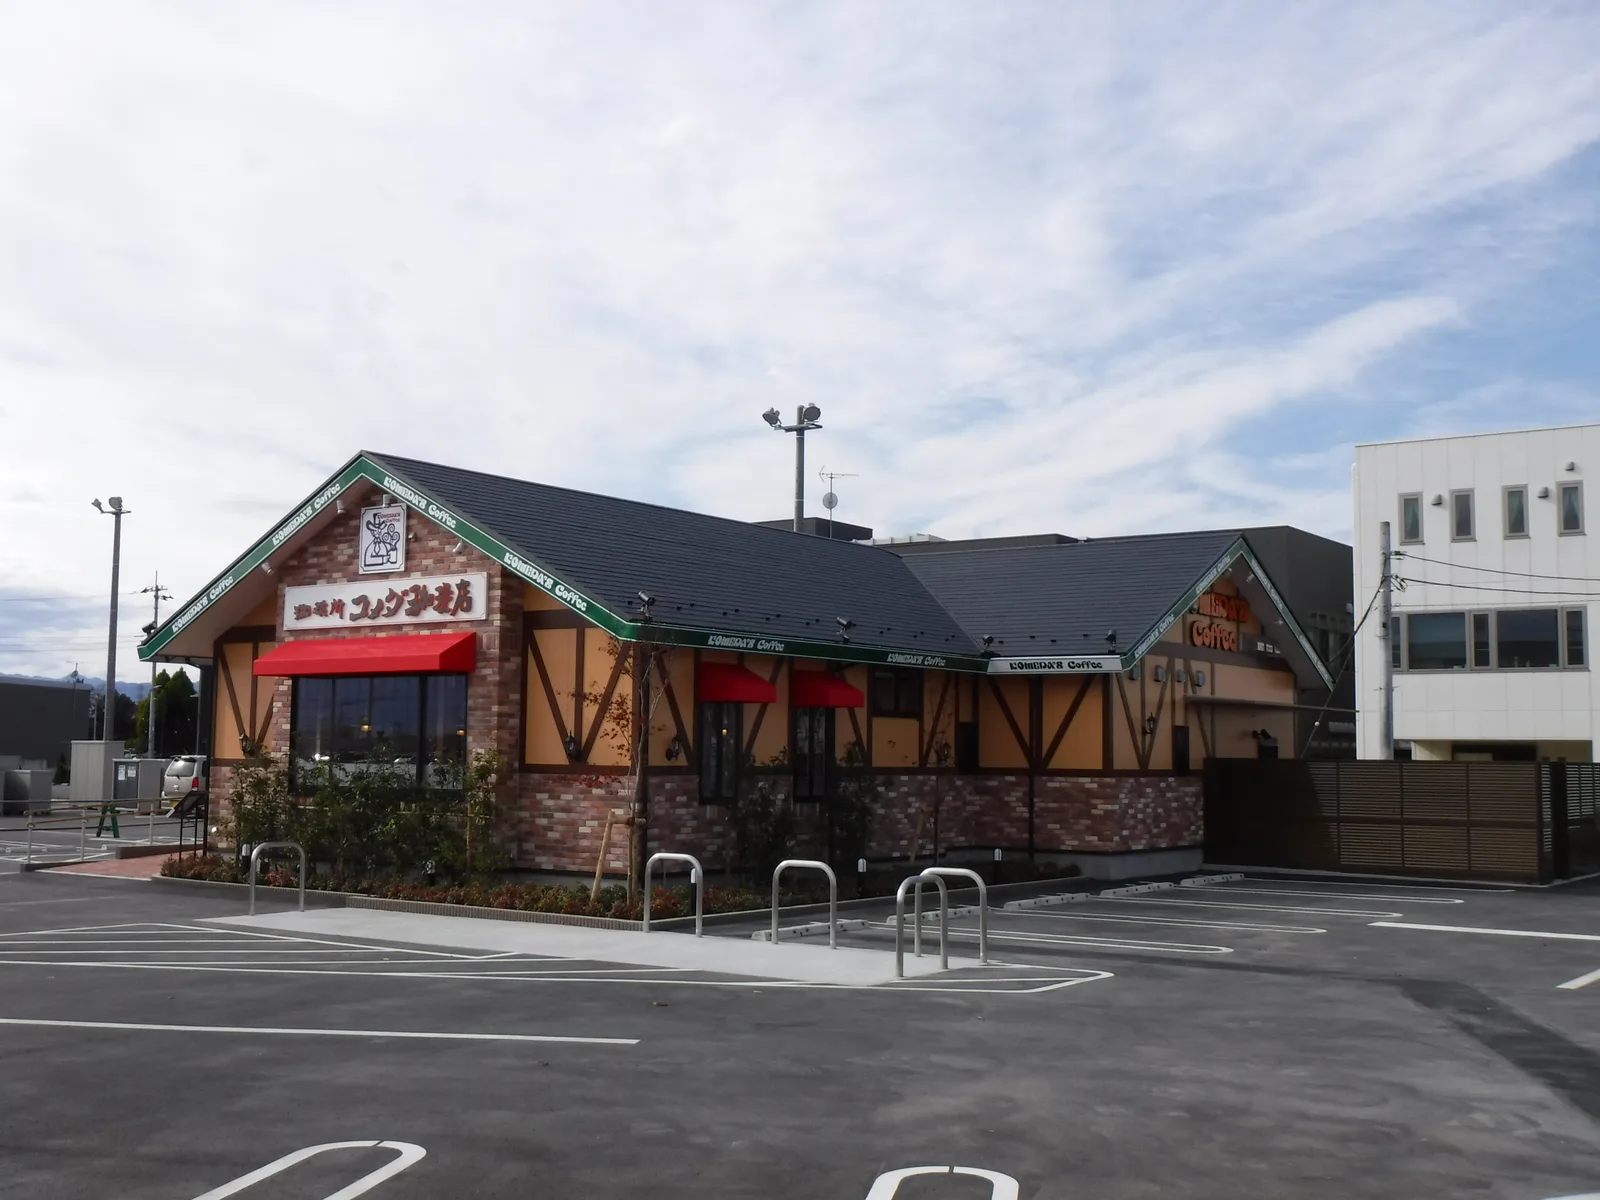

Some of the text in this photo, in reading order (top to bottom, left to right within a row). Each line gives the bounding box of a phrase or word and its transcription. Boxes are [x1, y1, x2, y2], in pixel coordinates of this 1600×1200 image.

[314, 483, 341, 509] Coffee
[383, 476, 457, 528] KOMEDA'S Coffee
[209, 576, 234, 600] Coffee
[504, 552, 587, 612] KOMEDA'S Coffee
[708, 635, 785, 651] KOMEDA'S Coffee
[1191, 620, 1238, 652] Coffee
[924, 656, 946, 667] Coffee
[1009, 660, 1103, 670] KOMEDA'S Coffee
